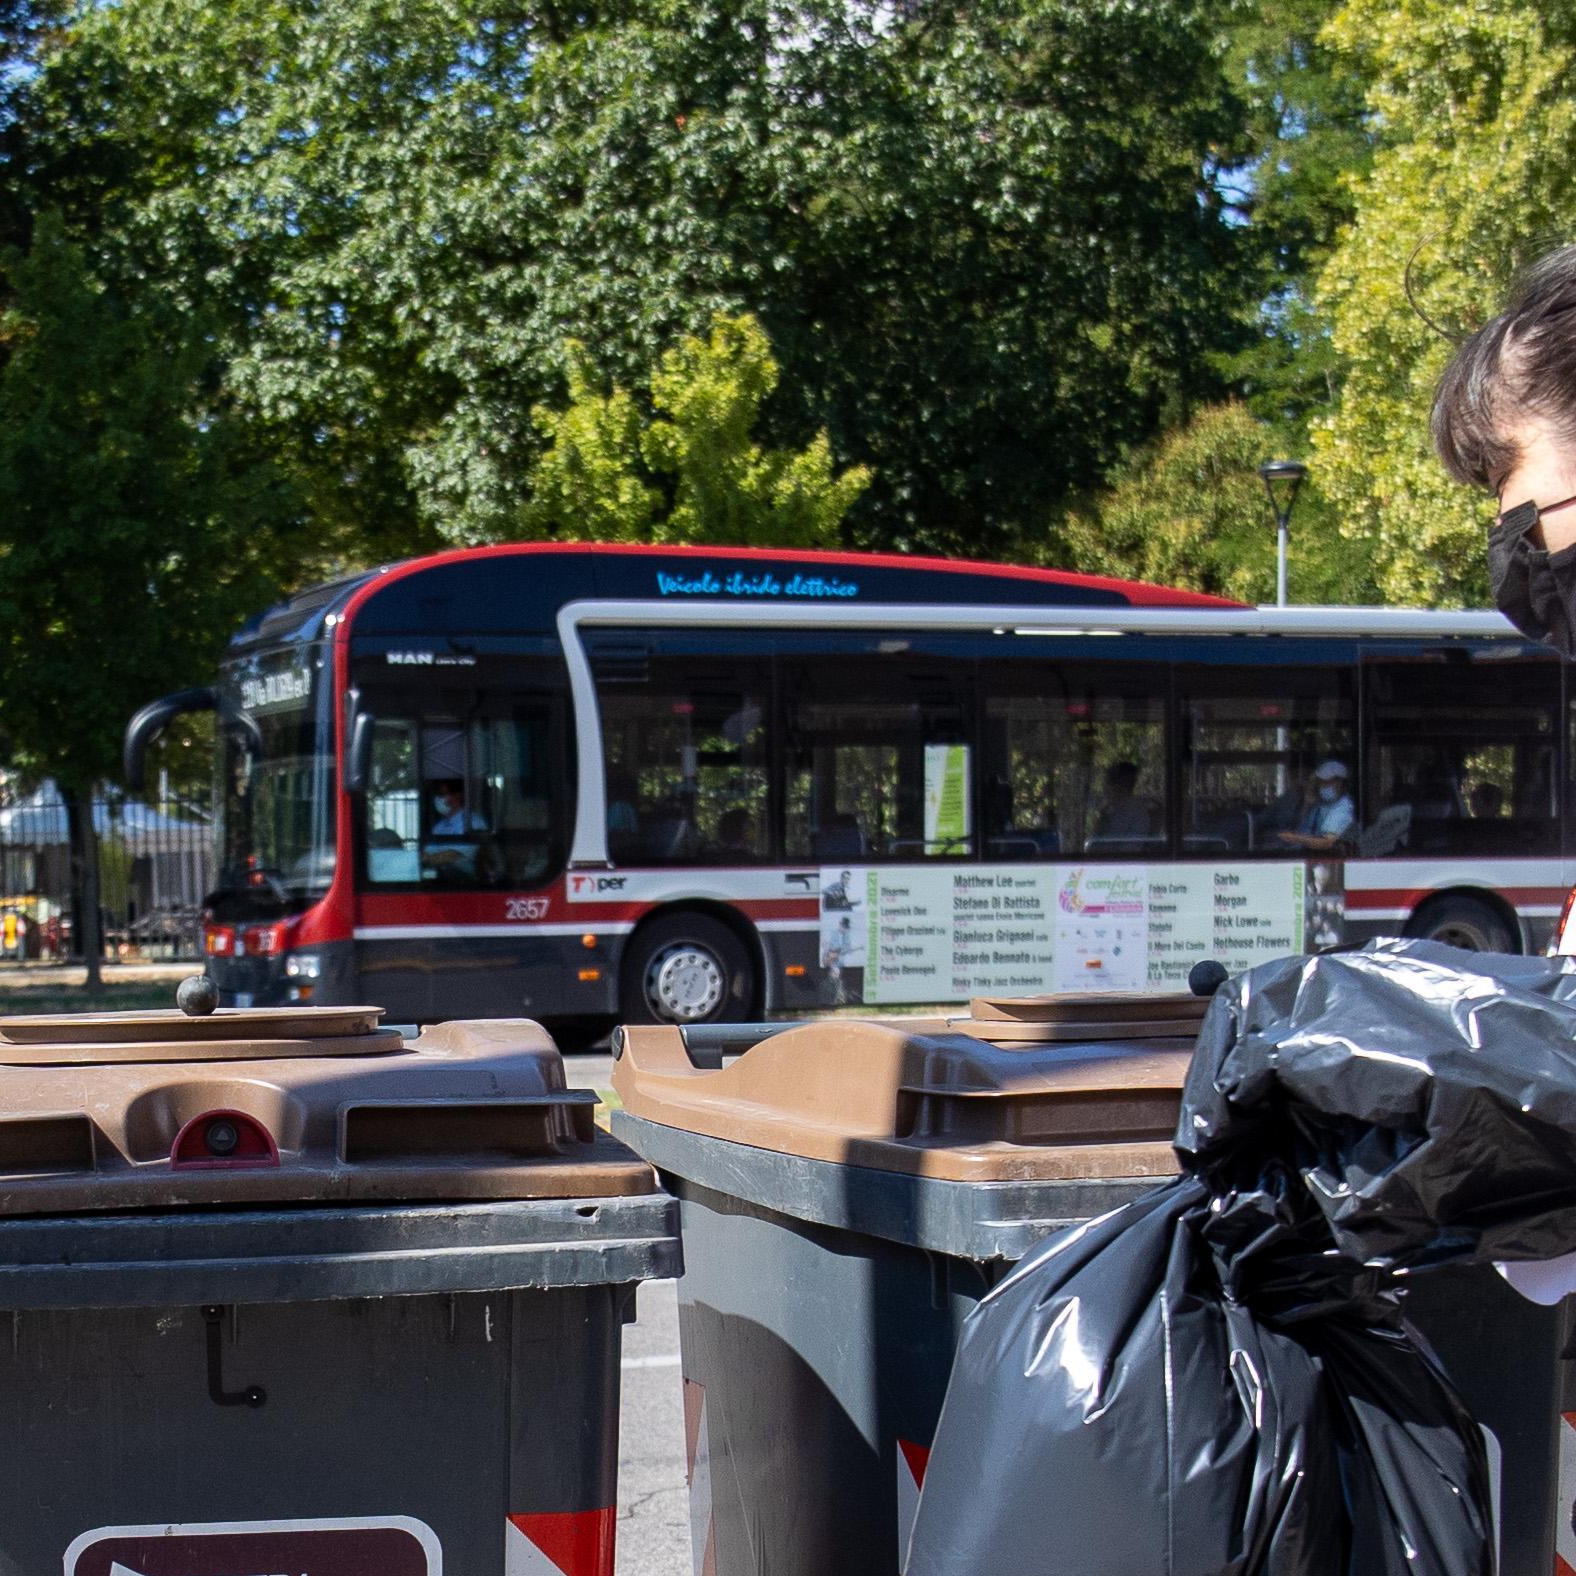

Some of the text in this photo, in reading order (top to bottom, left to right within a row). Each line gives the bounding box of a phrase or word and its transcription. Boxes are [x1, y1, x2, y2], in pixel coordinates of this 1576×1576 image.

[656, 571, 858, 596] Veicolo ibrido elettrico
[387, 653, 433, 665] MAN
[954, 875, 994, 888] Matthew
[996, 876, 1013, 888] Lee
[1214, 873, 1239, 885] Garbo
[953, 896, 1040, 910] Stefano Di Battista
[1214, 894, 1247, 909] Morgan
[506, 898, 550, 920] 2657
[1214, 915, 1233, 928] Nick
[1236, 915, 1258, 928] Lowe
[953, 930, 994, 943] Gianluca
[996, 930, 1034, 945] Grignani
[1213, 936, 1290, 949] Hothouse Flowers
[881, 945, 923, 957] The Cyborgs
[953, 952, 990, 964] Edoardo
[993, 951, 1030, 963] Bennato
[1009, 976, 1043, 986] Orchestra
